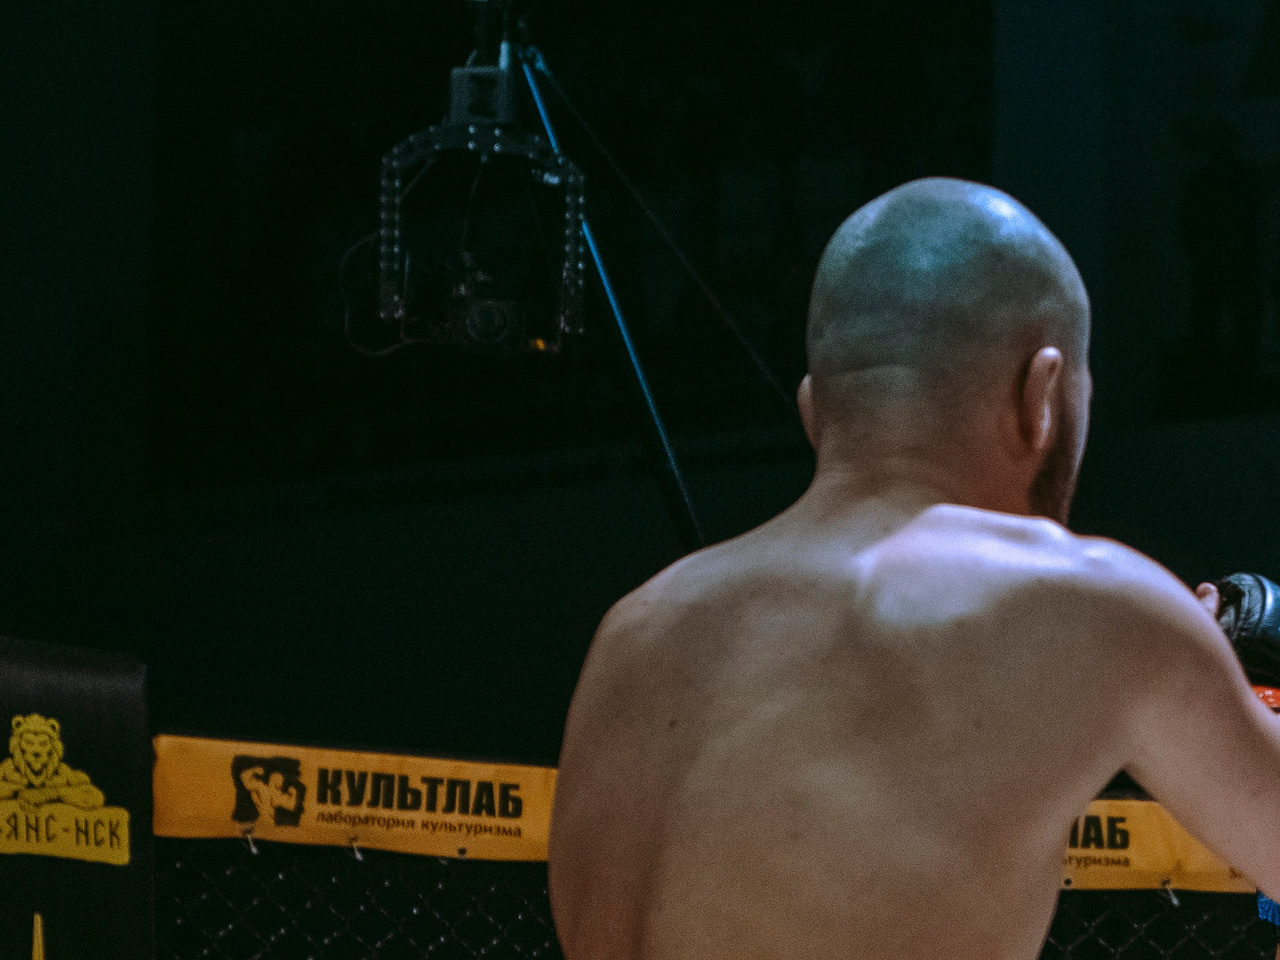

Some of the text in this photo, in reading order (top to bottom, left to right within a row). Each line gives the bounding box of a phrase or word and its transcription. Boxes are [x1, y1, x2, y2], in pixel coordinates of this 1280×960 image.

[316, 768, 523, 818] КУЛЬТЛАБ
[0, 812, 121, 848] ЯНС-НСК
[316, 811, 523, 838] лаборатория культуризма
